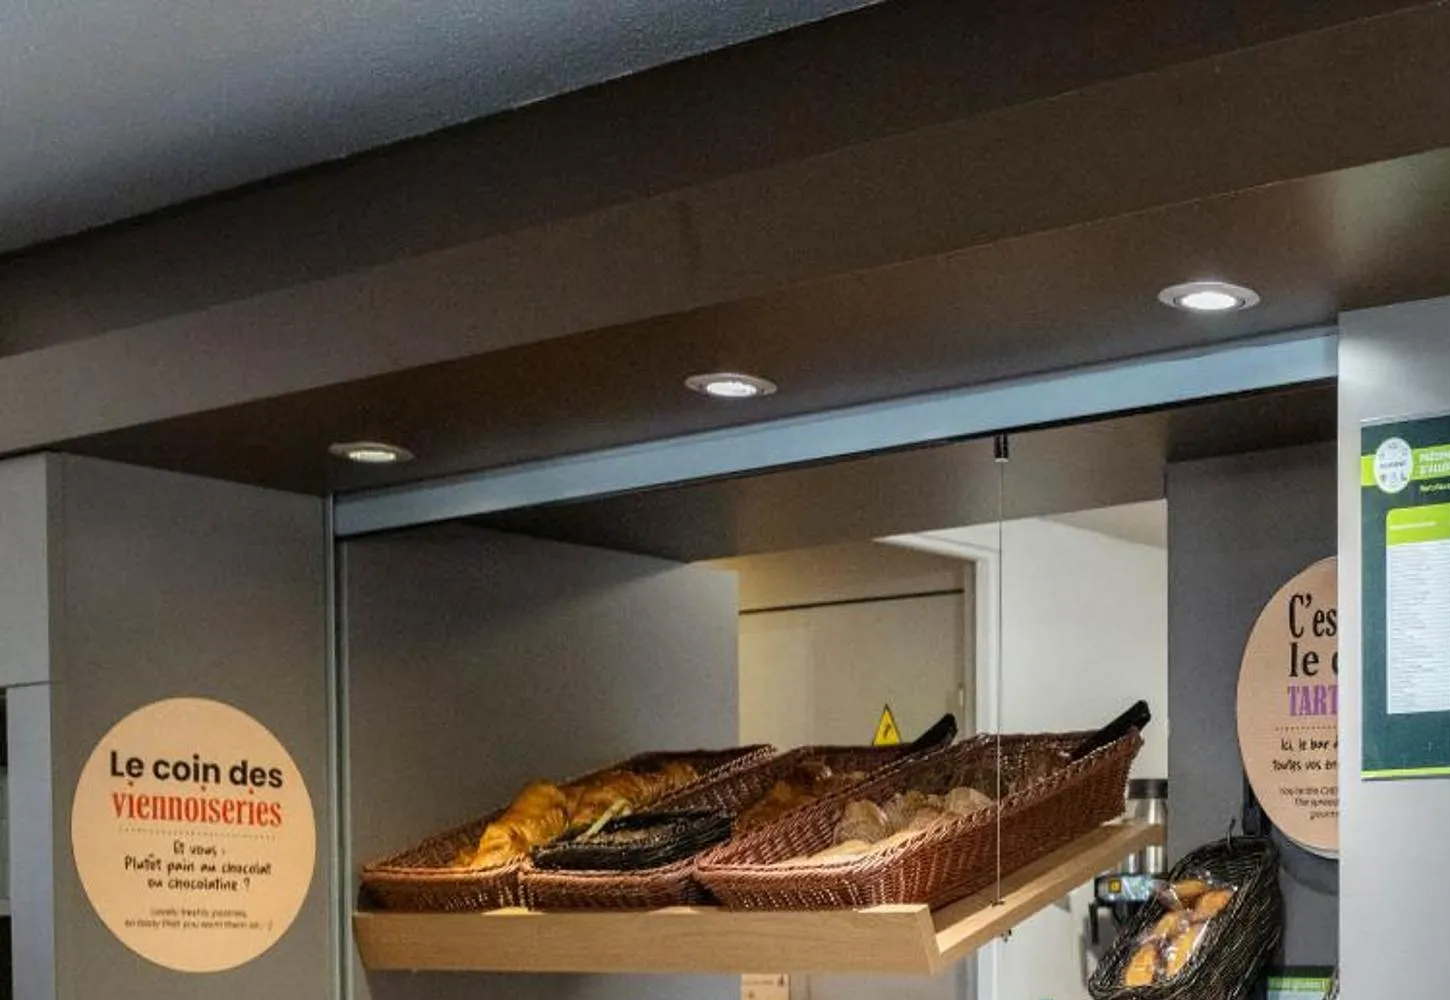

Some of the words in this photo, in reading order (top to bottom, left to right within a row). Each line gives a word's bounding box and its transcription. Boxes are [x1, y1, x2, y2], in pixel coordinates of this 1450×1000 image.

[1289, 642, 1319, 677] le
[110, 751, 144, 778] Le
[153, 754, 220, 784] coin
[229, 760, 283, 788] des
[113, 781, 283, 827] viennoiseries
[173, 840, 184, 855] Et
[167, 860, 195, 876] pain
[200, 864, 216, 873] au
[222, 862, 271, 876] chocolat
[147, 879, 163, 888] ou
[168, 878, 238, 892] chocolatine
